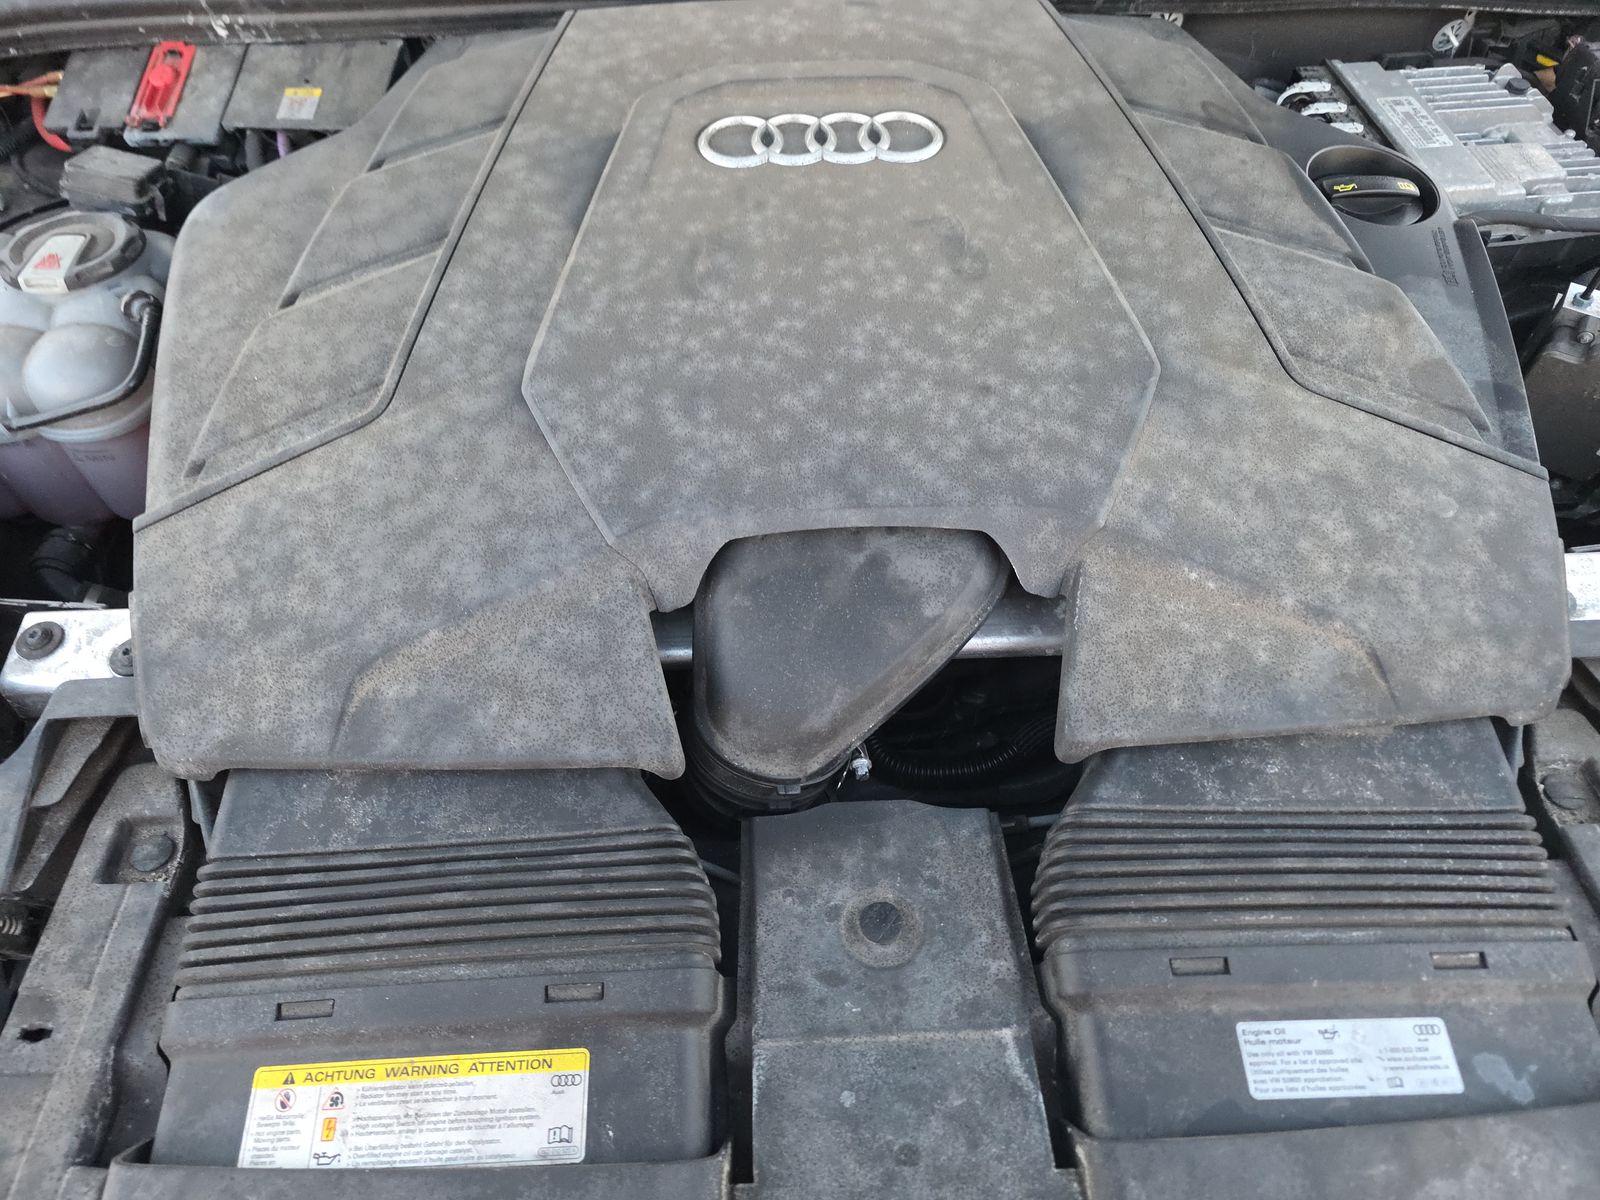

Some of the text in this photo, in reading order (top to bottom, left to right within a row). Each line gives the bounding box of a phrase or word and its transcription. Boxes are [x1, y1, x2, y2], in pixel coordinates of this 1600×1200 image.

[1241, 1029, 1271, 1037] Engine
[303, 1058, 552, 1082] ACHTUNG WARNING ATTENTION
